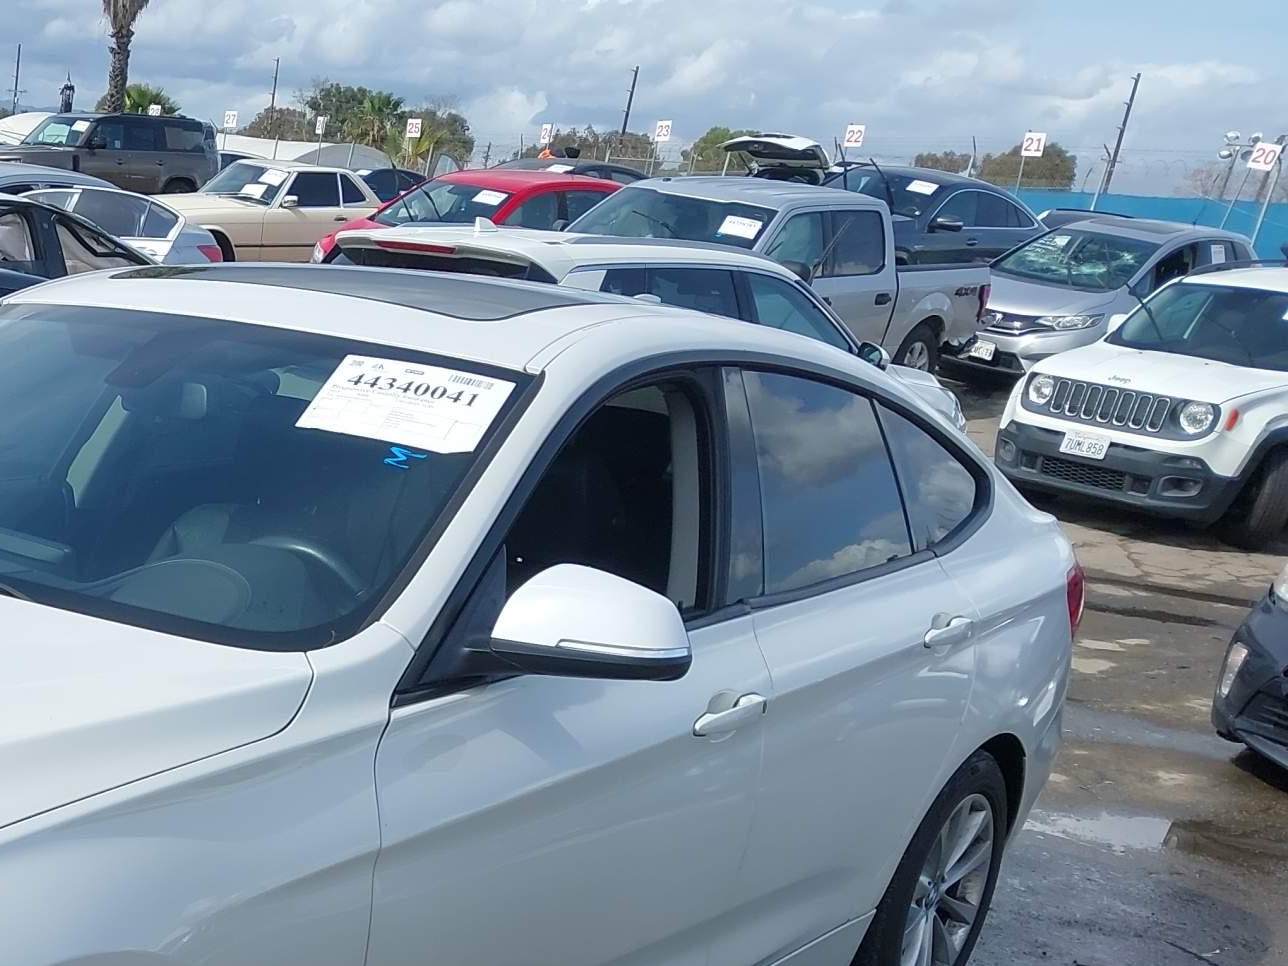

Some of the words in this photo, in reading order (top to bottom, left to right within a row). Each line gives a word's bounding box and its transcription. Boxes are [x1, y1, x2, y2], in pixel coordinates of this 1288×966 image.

[225, 114, 236, 124] 27
[407, 122, 421, 134] 25
[656, 125, 670, 137] 23
[846, 129, 863, 143] 22
[1023, 137, 1042, 152] 21
[1251, 147, 1277, 166] 20
[347, 372, 480, 408] 44340041
[1064, 437, 1105, 456] 7UML858
